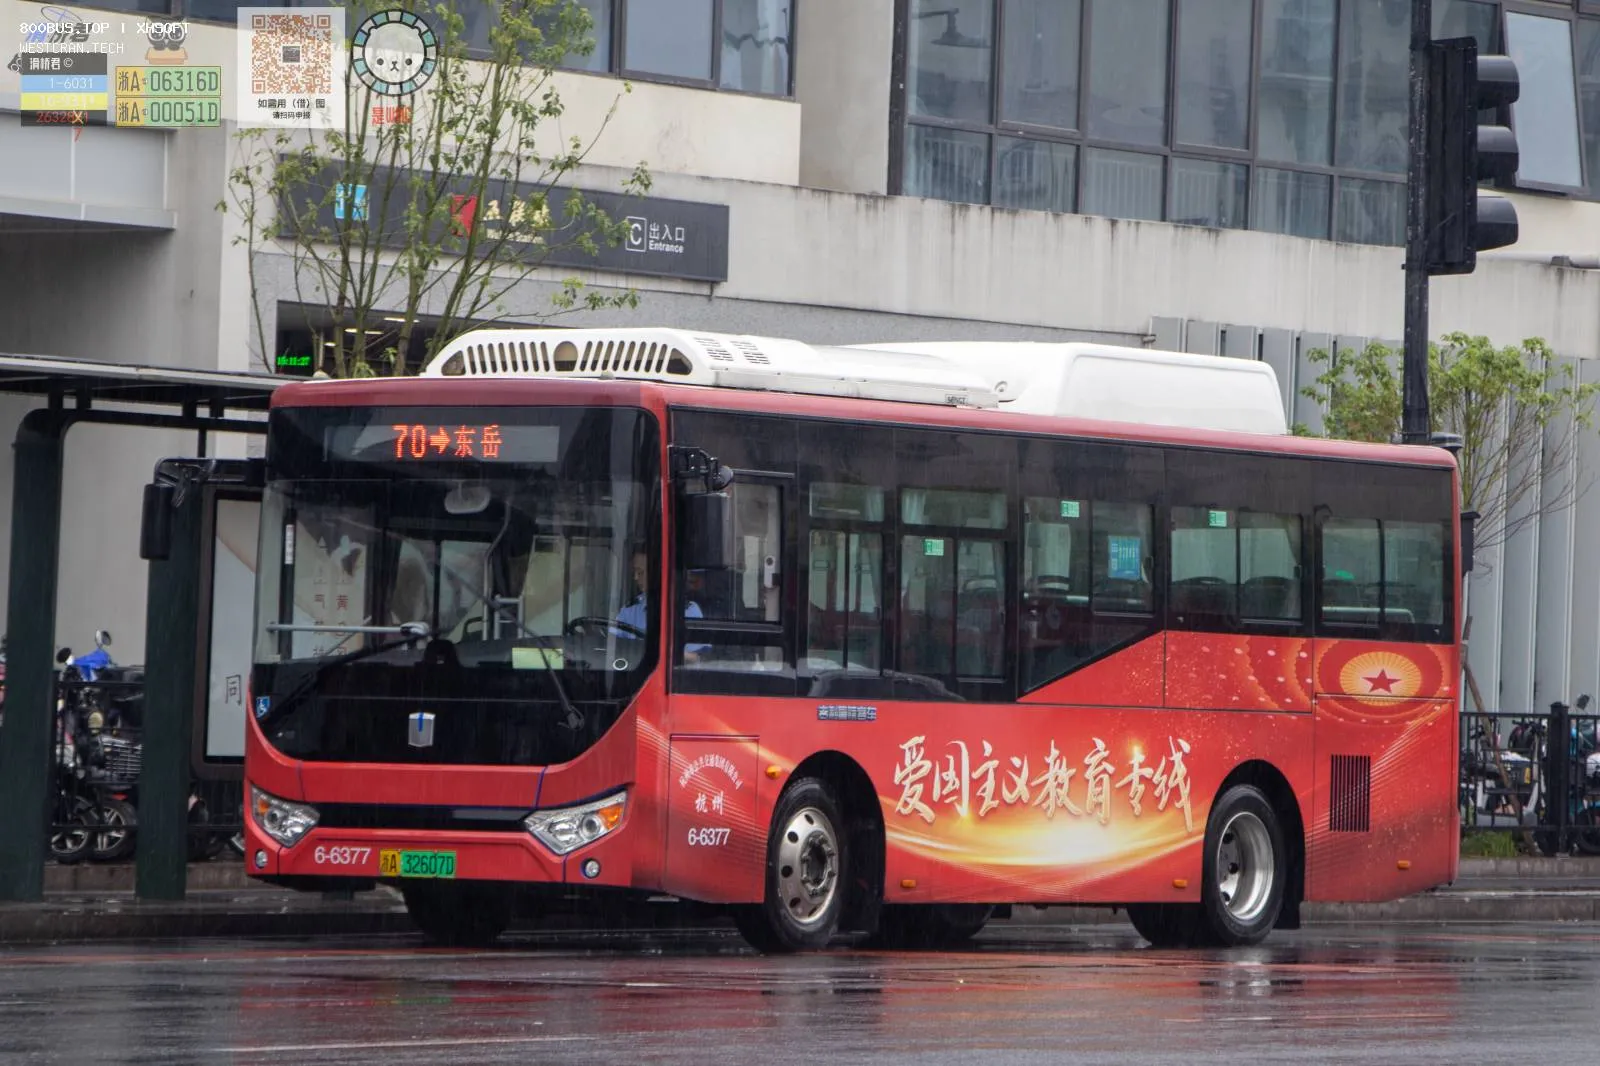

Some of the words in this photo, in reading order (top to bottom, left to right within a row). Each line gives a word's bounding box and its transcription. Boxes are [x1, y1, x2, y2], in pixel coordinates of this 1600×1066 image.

[629, 223, 642, 245] C
[648, 222, 685, 243] 出入口
[648, 239, 685, 253] Entrance
[392, 424, 427, 458] 70
[453, 424, 503, 458] 东岳
[893, 735, 1193, 833] 爱国主义教育专线
[688, 827, 732, 846] 6-6377
[314, 846, 372, 865] 6-6377
